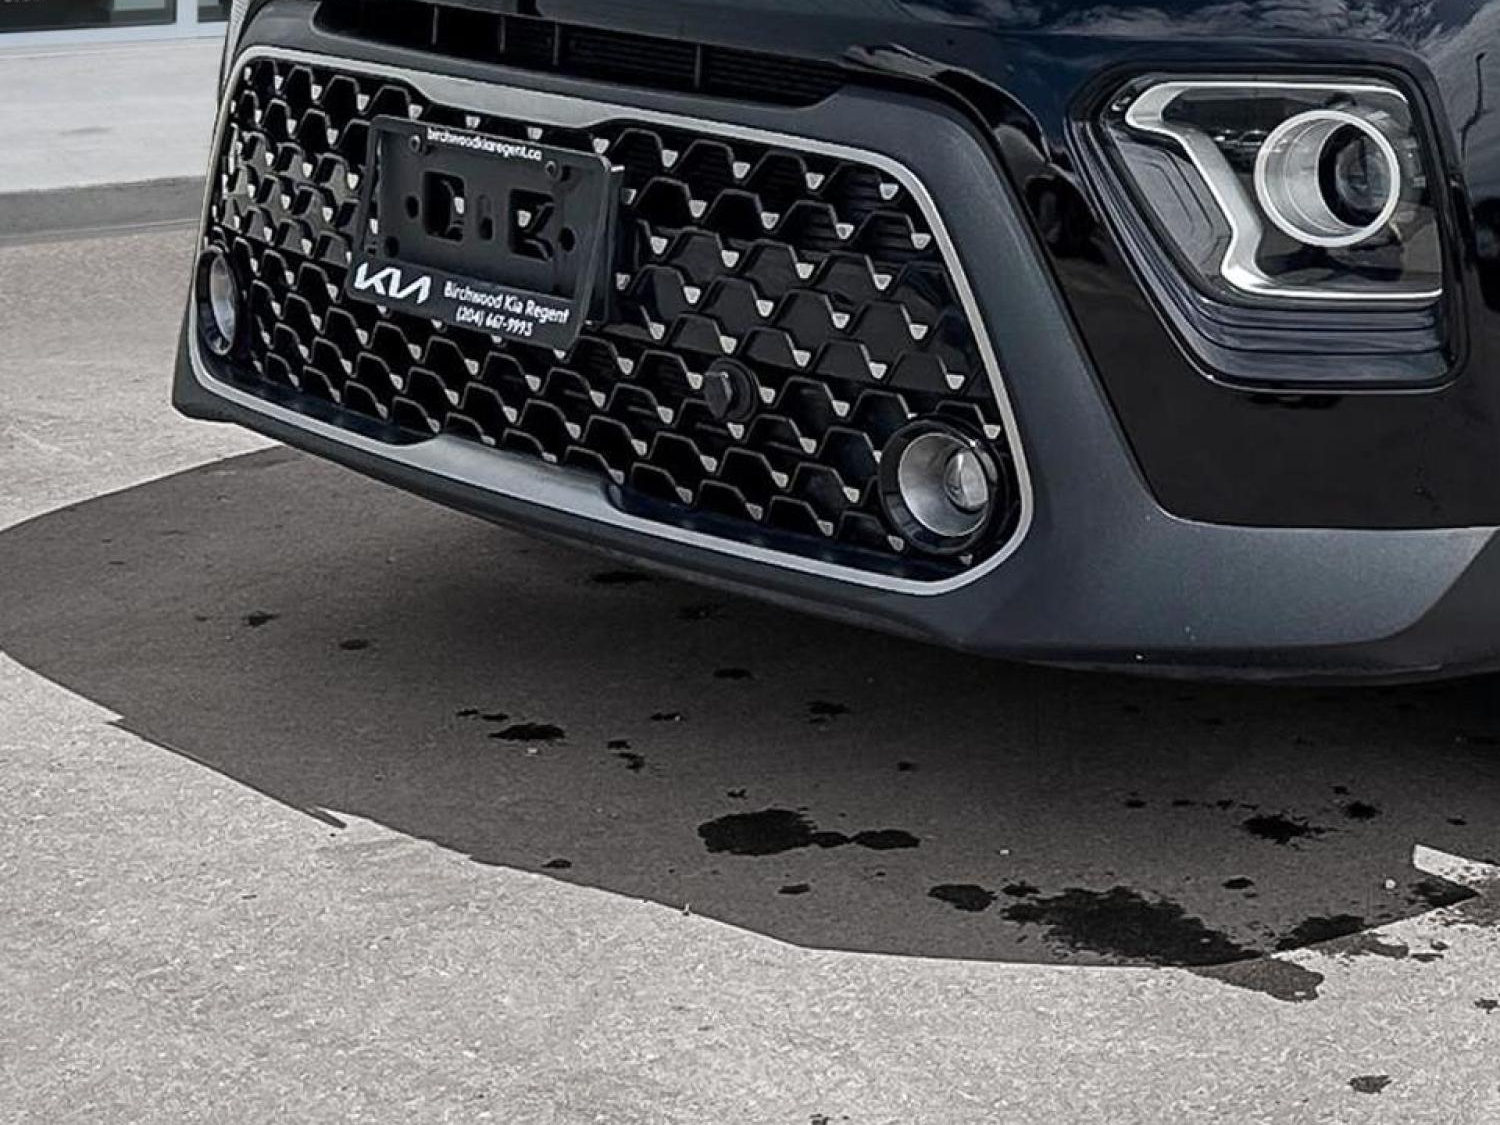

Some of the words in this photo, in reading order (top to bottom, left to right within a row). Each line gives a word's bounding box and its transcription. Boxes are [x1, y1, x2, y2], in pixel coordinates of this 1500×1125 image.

[427, 127, 542, 161] birchwoodkiaregent.ca
[444, 281, 503, 308] Birchwood
[504, 292, 523, 313] Kia
[525, 299, 570, 324] Regent
[456, 305, 484, 327] (204)
